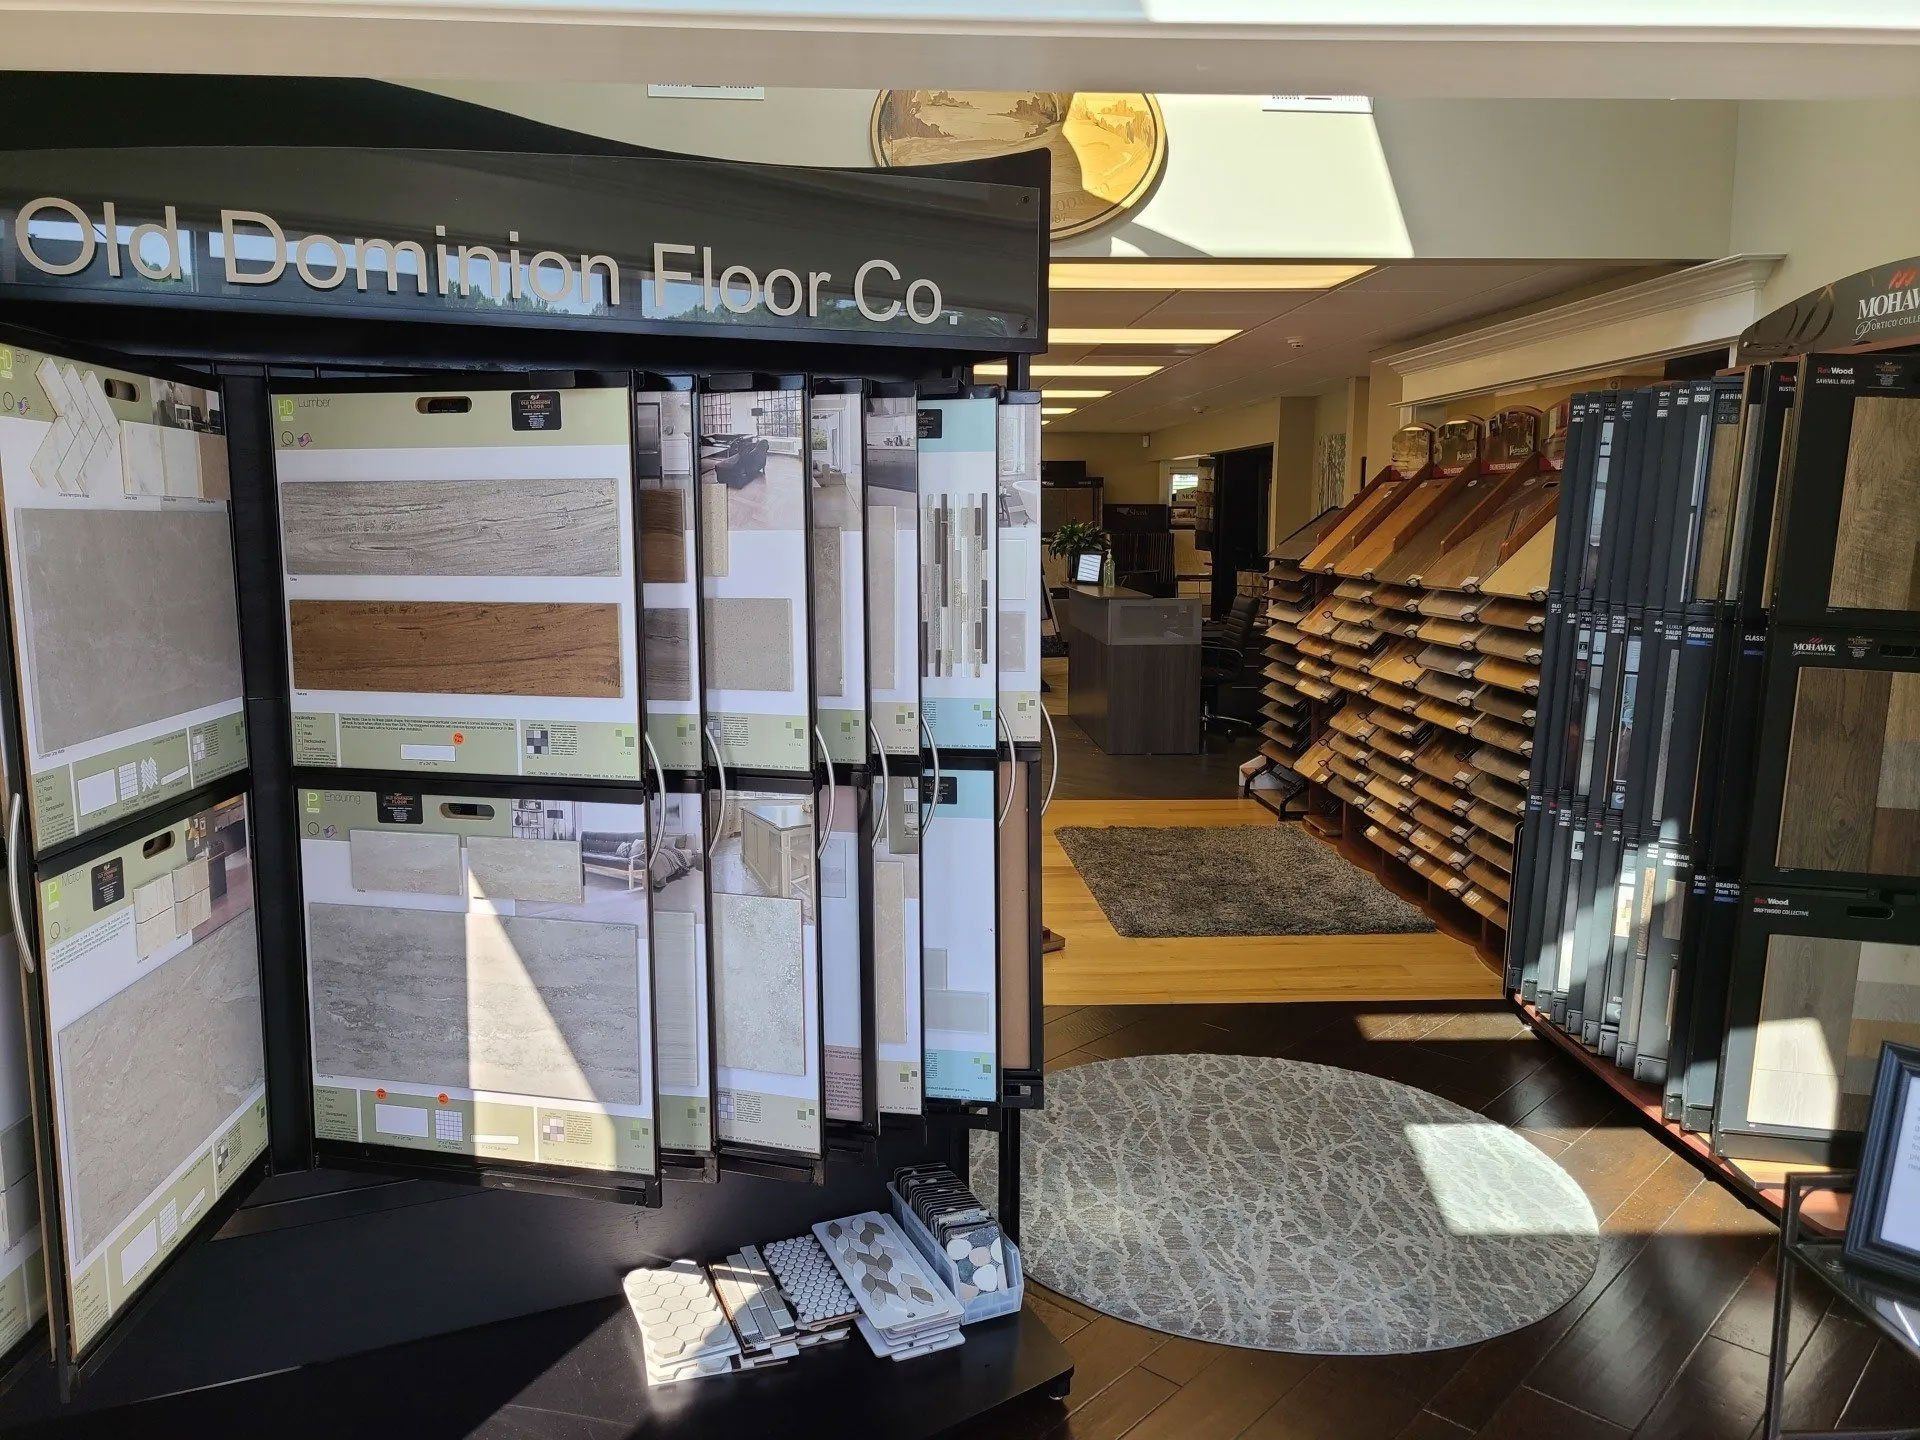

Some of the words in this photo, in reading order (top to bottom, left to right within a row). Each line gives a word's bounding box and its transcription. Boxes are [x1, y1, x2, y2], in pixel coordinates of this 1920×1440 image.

[15, 196, 182, 281] Old
[220, 208, 621, 306] Dominion
[653, 242, 832, 318] Floor
[853, 258, 959, 326] Co.
[1792, 642, 1837, 652] MOHAWK
